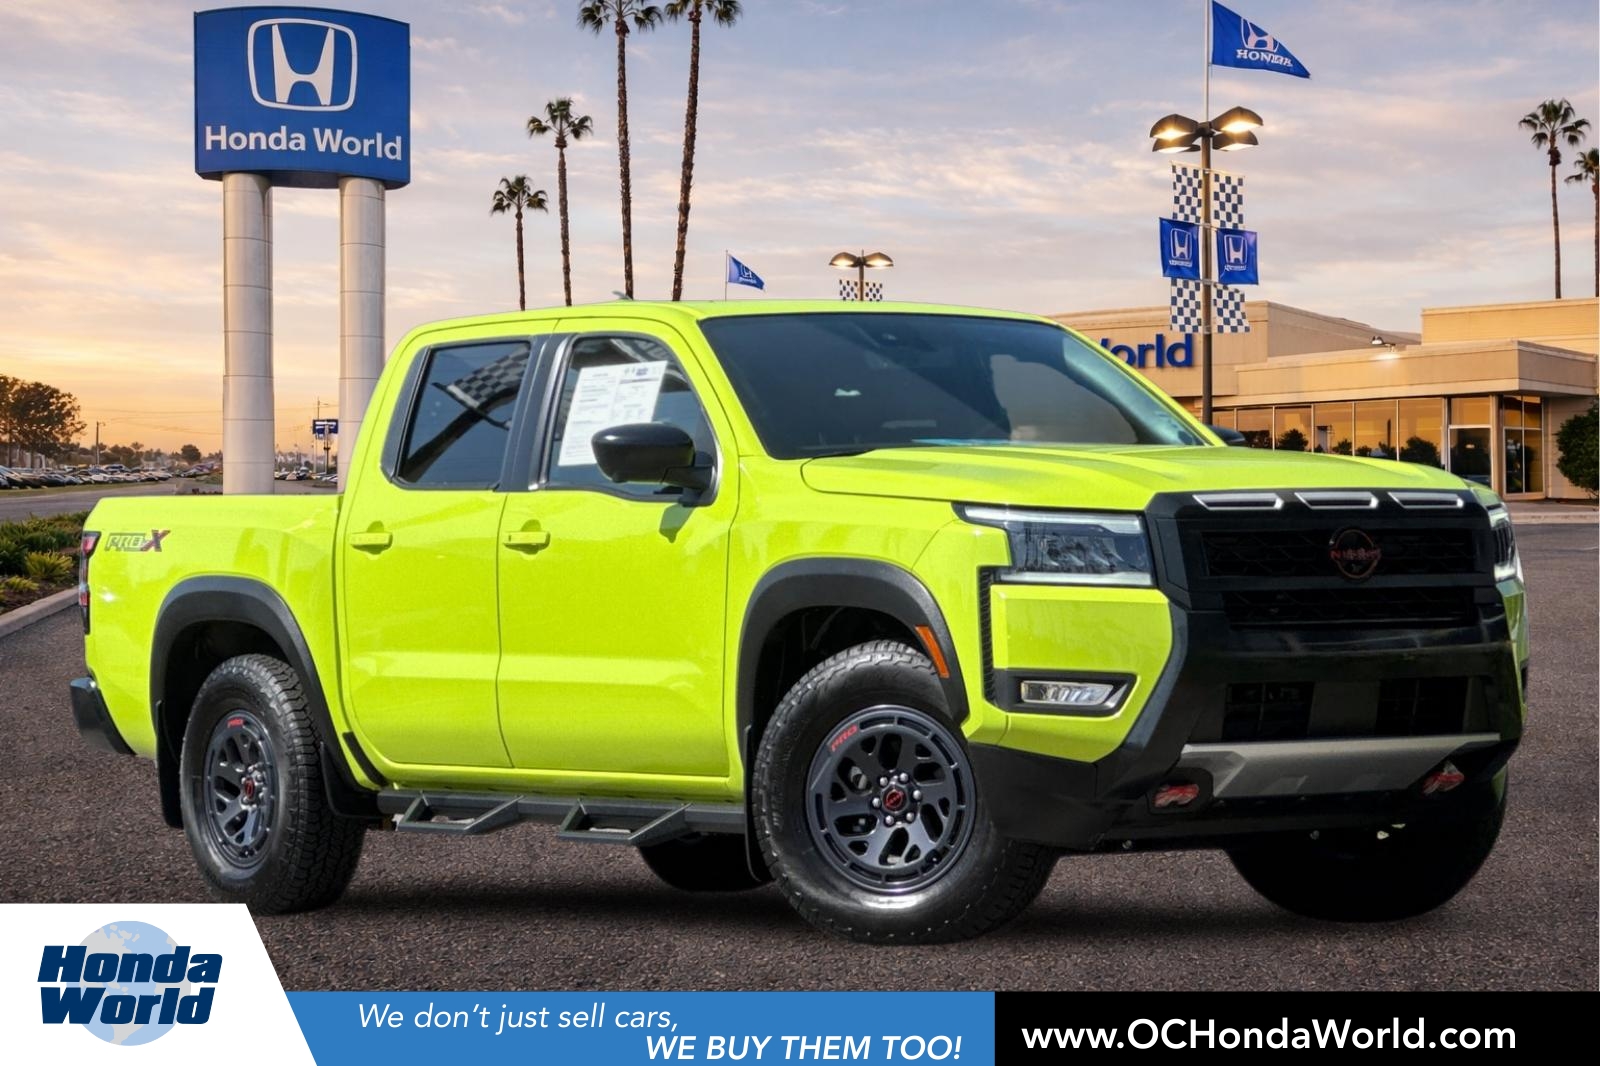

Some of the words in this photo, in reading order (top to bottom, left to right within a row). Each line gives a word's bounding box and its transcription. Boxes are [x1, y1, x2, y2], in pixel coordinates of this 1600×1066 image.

[205, 125, 306, 151] Honda
[313, 127, 402, 161] World
[1101, 333, 1193, 369] orld
